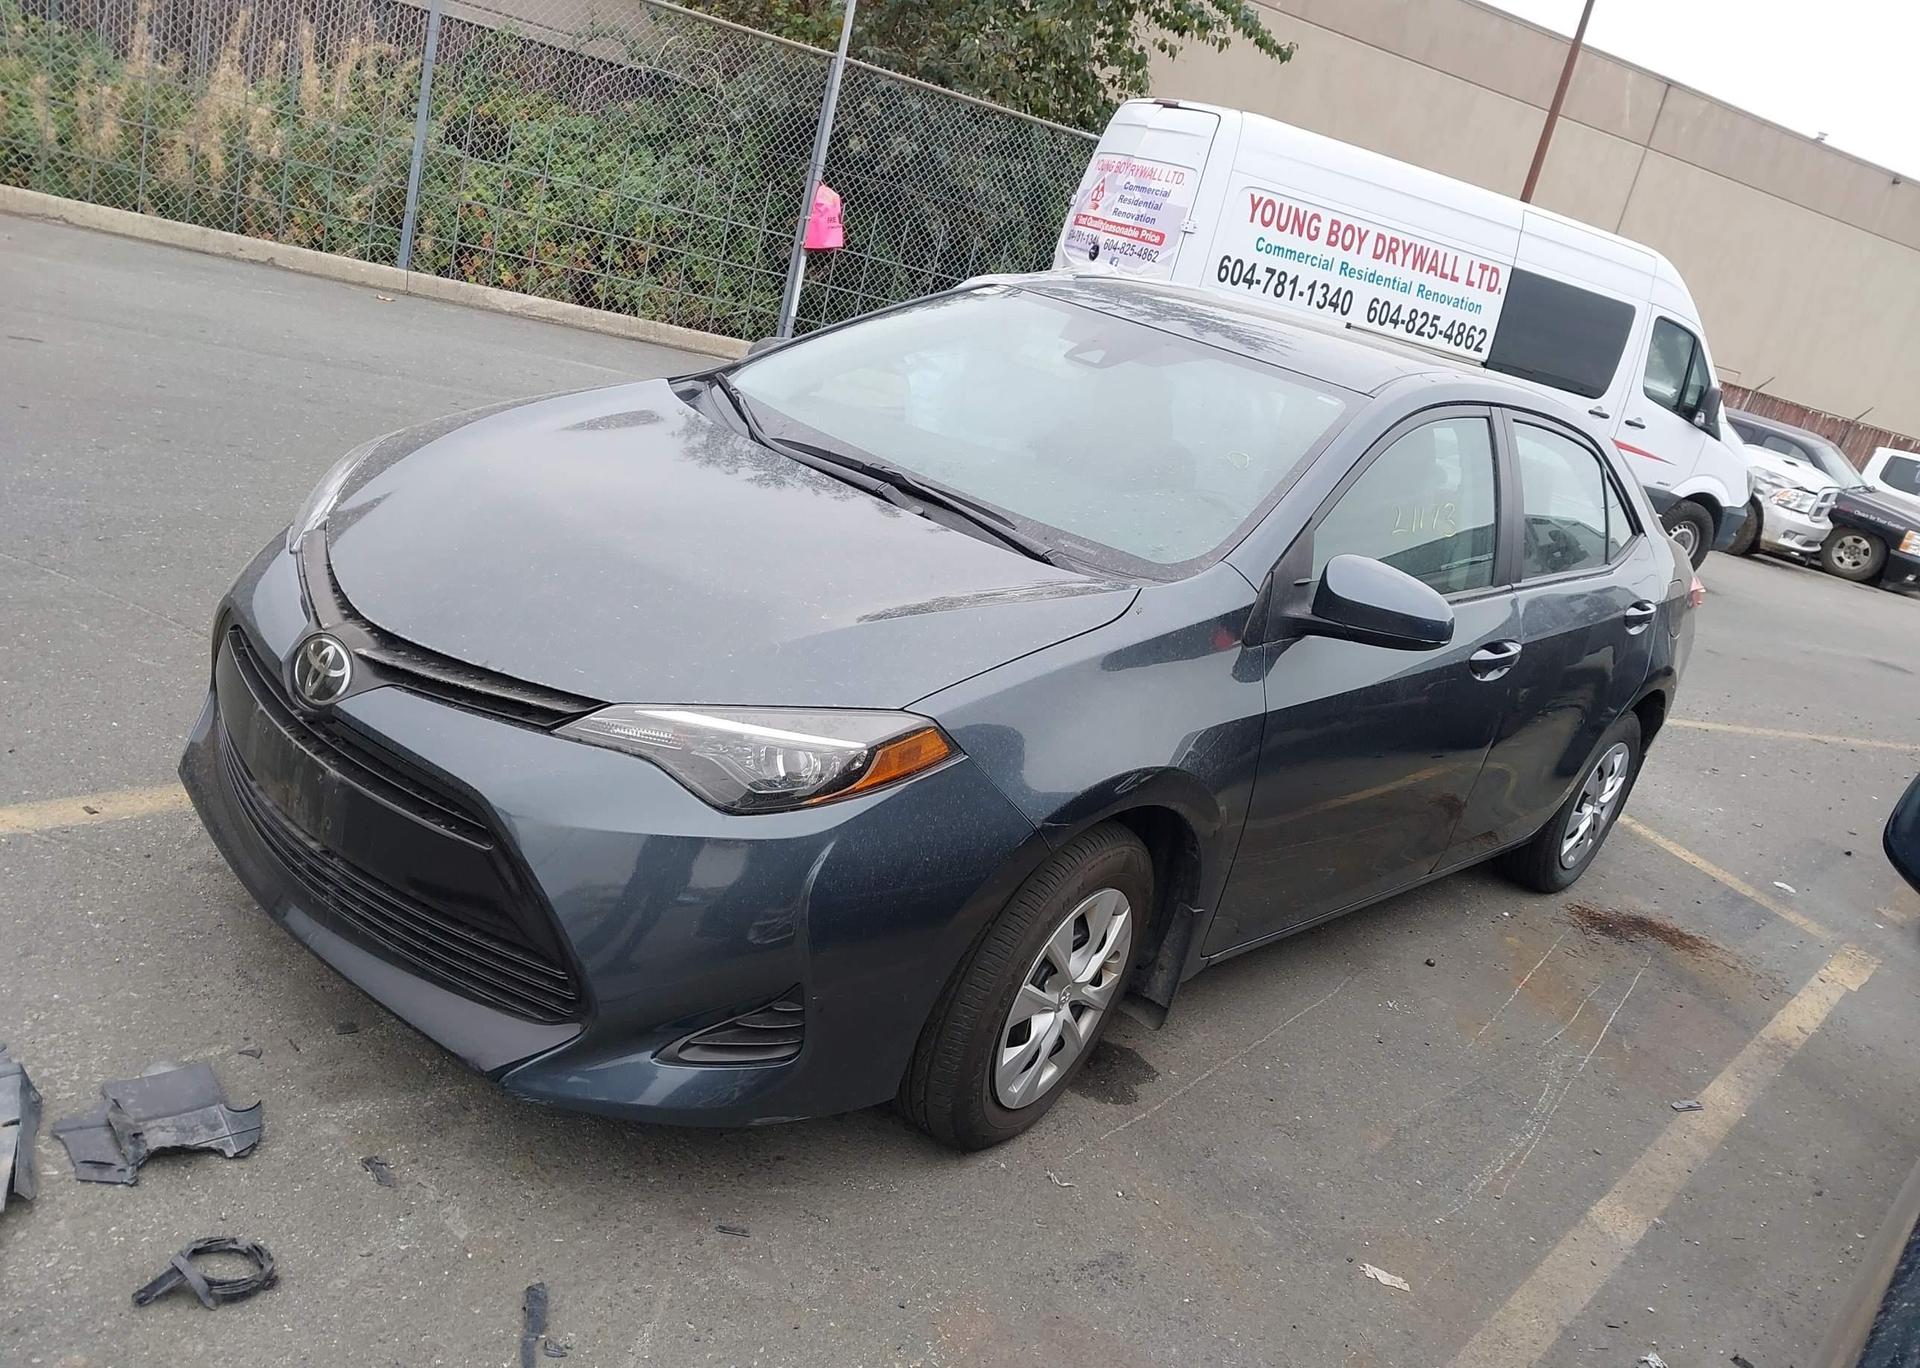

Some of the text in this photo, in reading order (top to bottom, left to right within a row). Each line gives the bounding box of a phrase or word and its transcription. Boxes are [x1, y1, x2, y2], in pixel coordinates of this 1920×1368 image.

[1164, 170, 1185, 186] LTD.
[1123, 181, 1171, 198] Commercial
[1117, 194, 1162, 211] Residential
[1112, 208, 1156, 225] Renovation
[1140, 229, 1160, 243] Price
[1249, 193, 1502, 295] YOUNG BOY DRYWALL LTD.
[1103, 238, 1160, 263] 604-825-4862
[1255, 236, 1482, 315] Commercial Residential Renovation
[1217, 254, 1488, 353] 604-781-1340 604-825-4862
